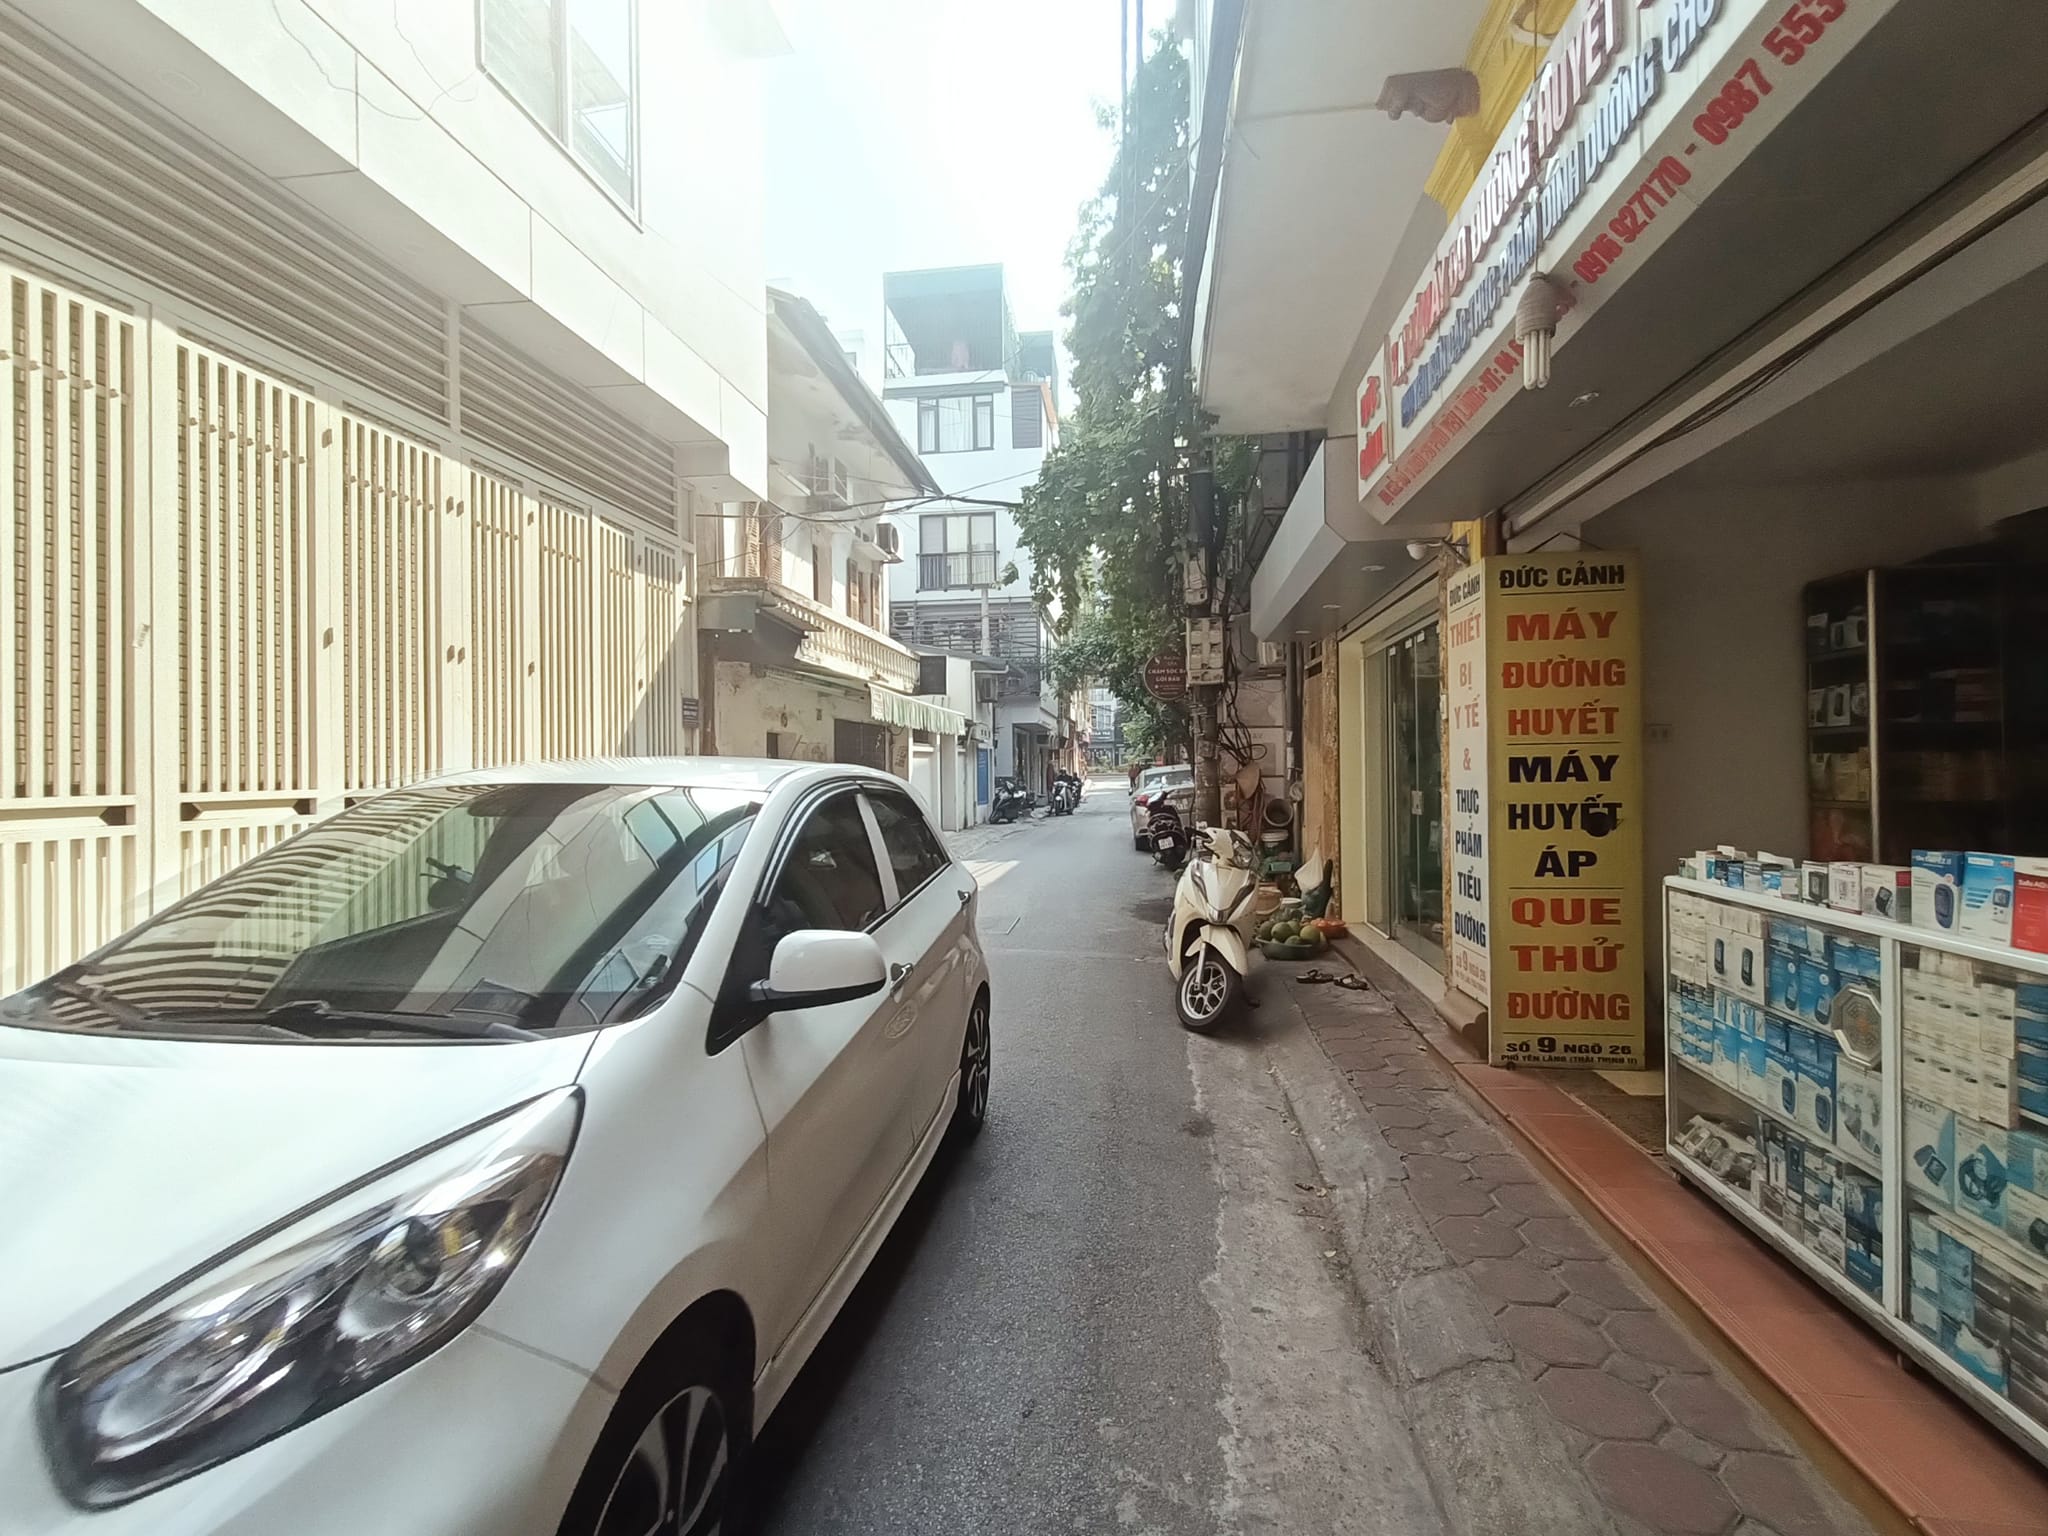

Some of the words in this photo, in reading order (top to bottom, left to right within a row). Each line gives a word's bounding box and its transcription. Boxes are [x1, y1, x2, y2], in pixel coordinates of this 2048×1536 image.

[1585, 40, 1655, 184] DƯỠNG
[1573, 233, 1623, 284] 0916
[1608, 155, 1692, 243] 927170
[1692, 57, 1773, 145] 0987
[1470, 120, 1531, 262] ĐƯỜNG
[1499, 564, 1548, 588] ĐỨC
[1557, 560, 1625, 586] CẢNH
[1450, 607, 1481, 649] THIẾT
[1506, 607, 1618, 641] MÁY
[1459, 661, 1473, 691] BỊ
[1502, 654, 1627, 689] ĐƯỜNG
[1454, 706, 1462, 730] Y
[1465, 694, 1481, 728] TẾ
[1508, 698, 1620, 736] HUYẾT
[1462, 747, 1472, 771] &
[1508, 750, 1620, 783] MÁY
[1456, 788, 1480, 819] THỰC
[1455, 822, 1483, 859] PHẨM
[1534, 845, 1598, 878] ÁP
[1457, 865, 1482, 901] TIỂU
[1454, 911, 1487, 948] ĐƯỜNG
[1511, 897, 1622, 928] QUE
[1509, 936, 1625, 973] THỬ
[1507, 986, 1630, 1021] ĐƯỜNG
[1506, 1040, 1531, 1053] SỐ
[1537, 1036, 1557, 1053] 9
[1563, 1042, 1603, 1055] NGÕ
[1609, 1045, 1632, 1055] 26
